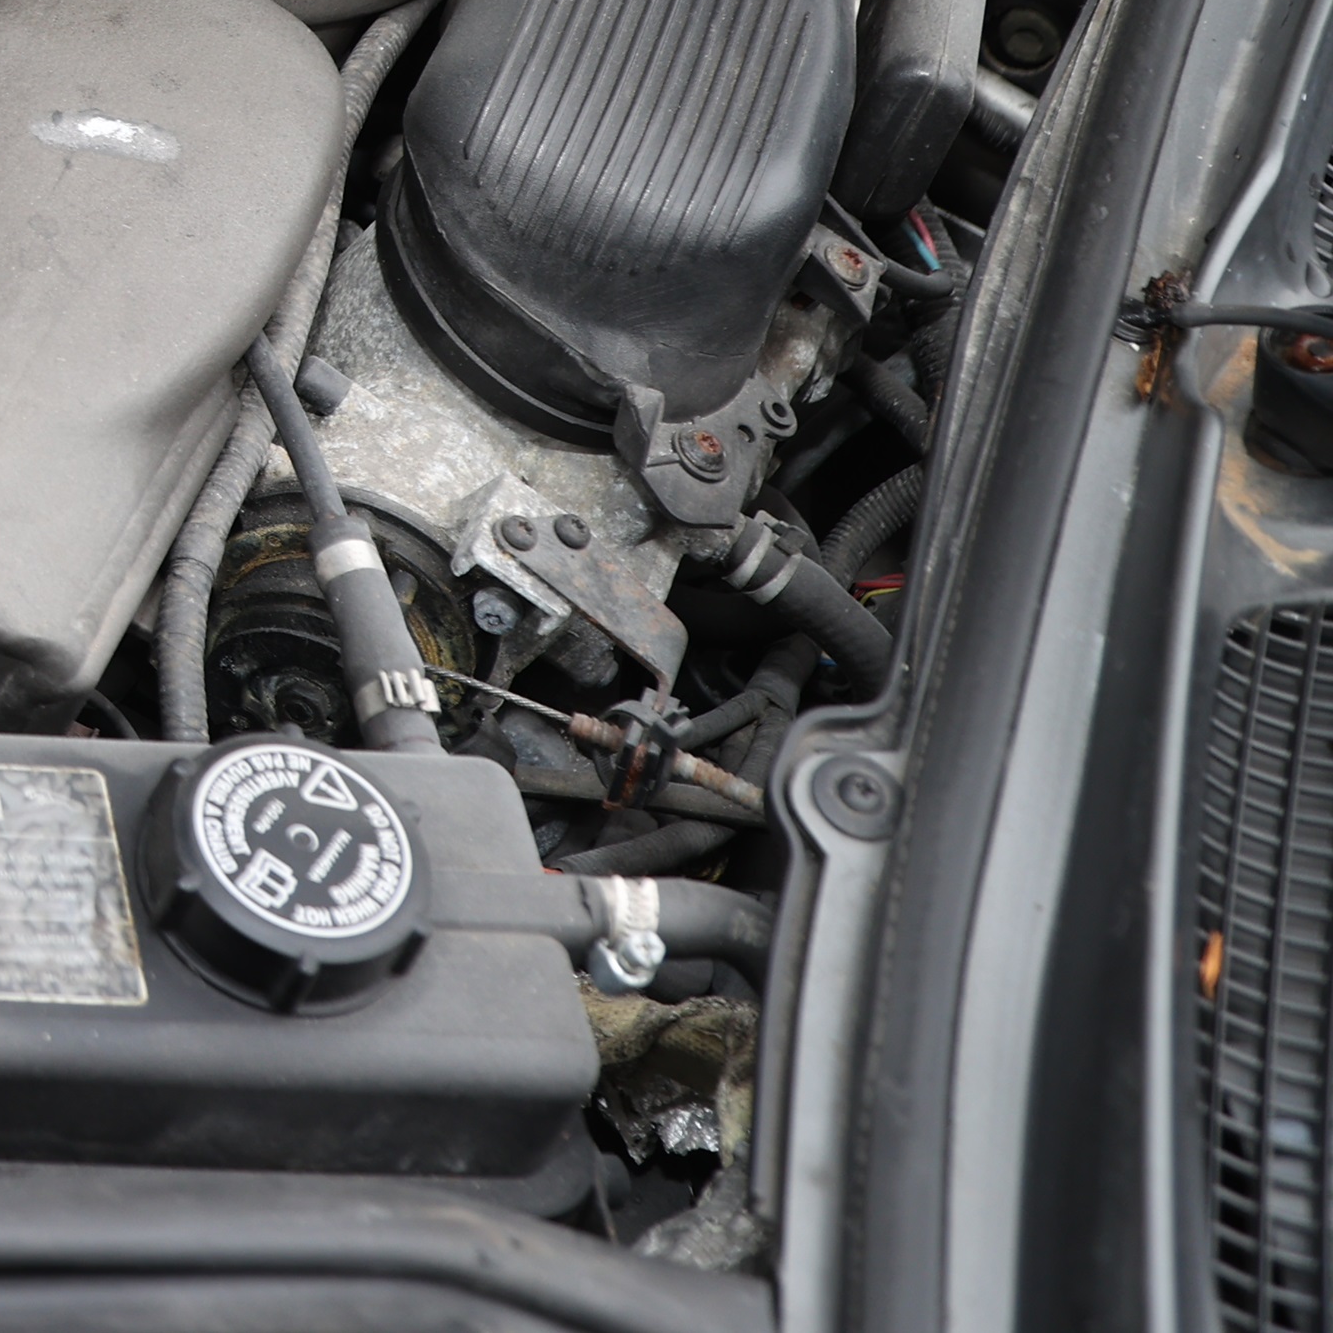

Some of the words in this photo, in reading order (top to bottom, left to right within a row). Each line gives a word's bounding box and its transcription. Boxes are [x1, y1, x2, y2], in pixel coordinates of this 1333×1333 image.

[248, 752, 285, 769] PAS
[285, 753, 312, 772] NE
[207, 759, 252, 806] OUVRIR
[222, 769, 300, 856] AVERTISSEMENT
[362, 802, 390, 828] DO
[204, 817, 238, 874] CHAUD
[376, 828, 401, 864] NOT
[327, 843, 381, 905] WARNING
[370, 860, 401, 904] OPEN
[333, 897, 382, 926] WHEN
